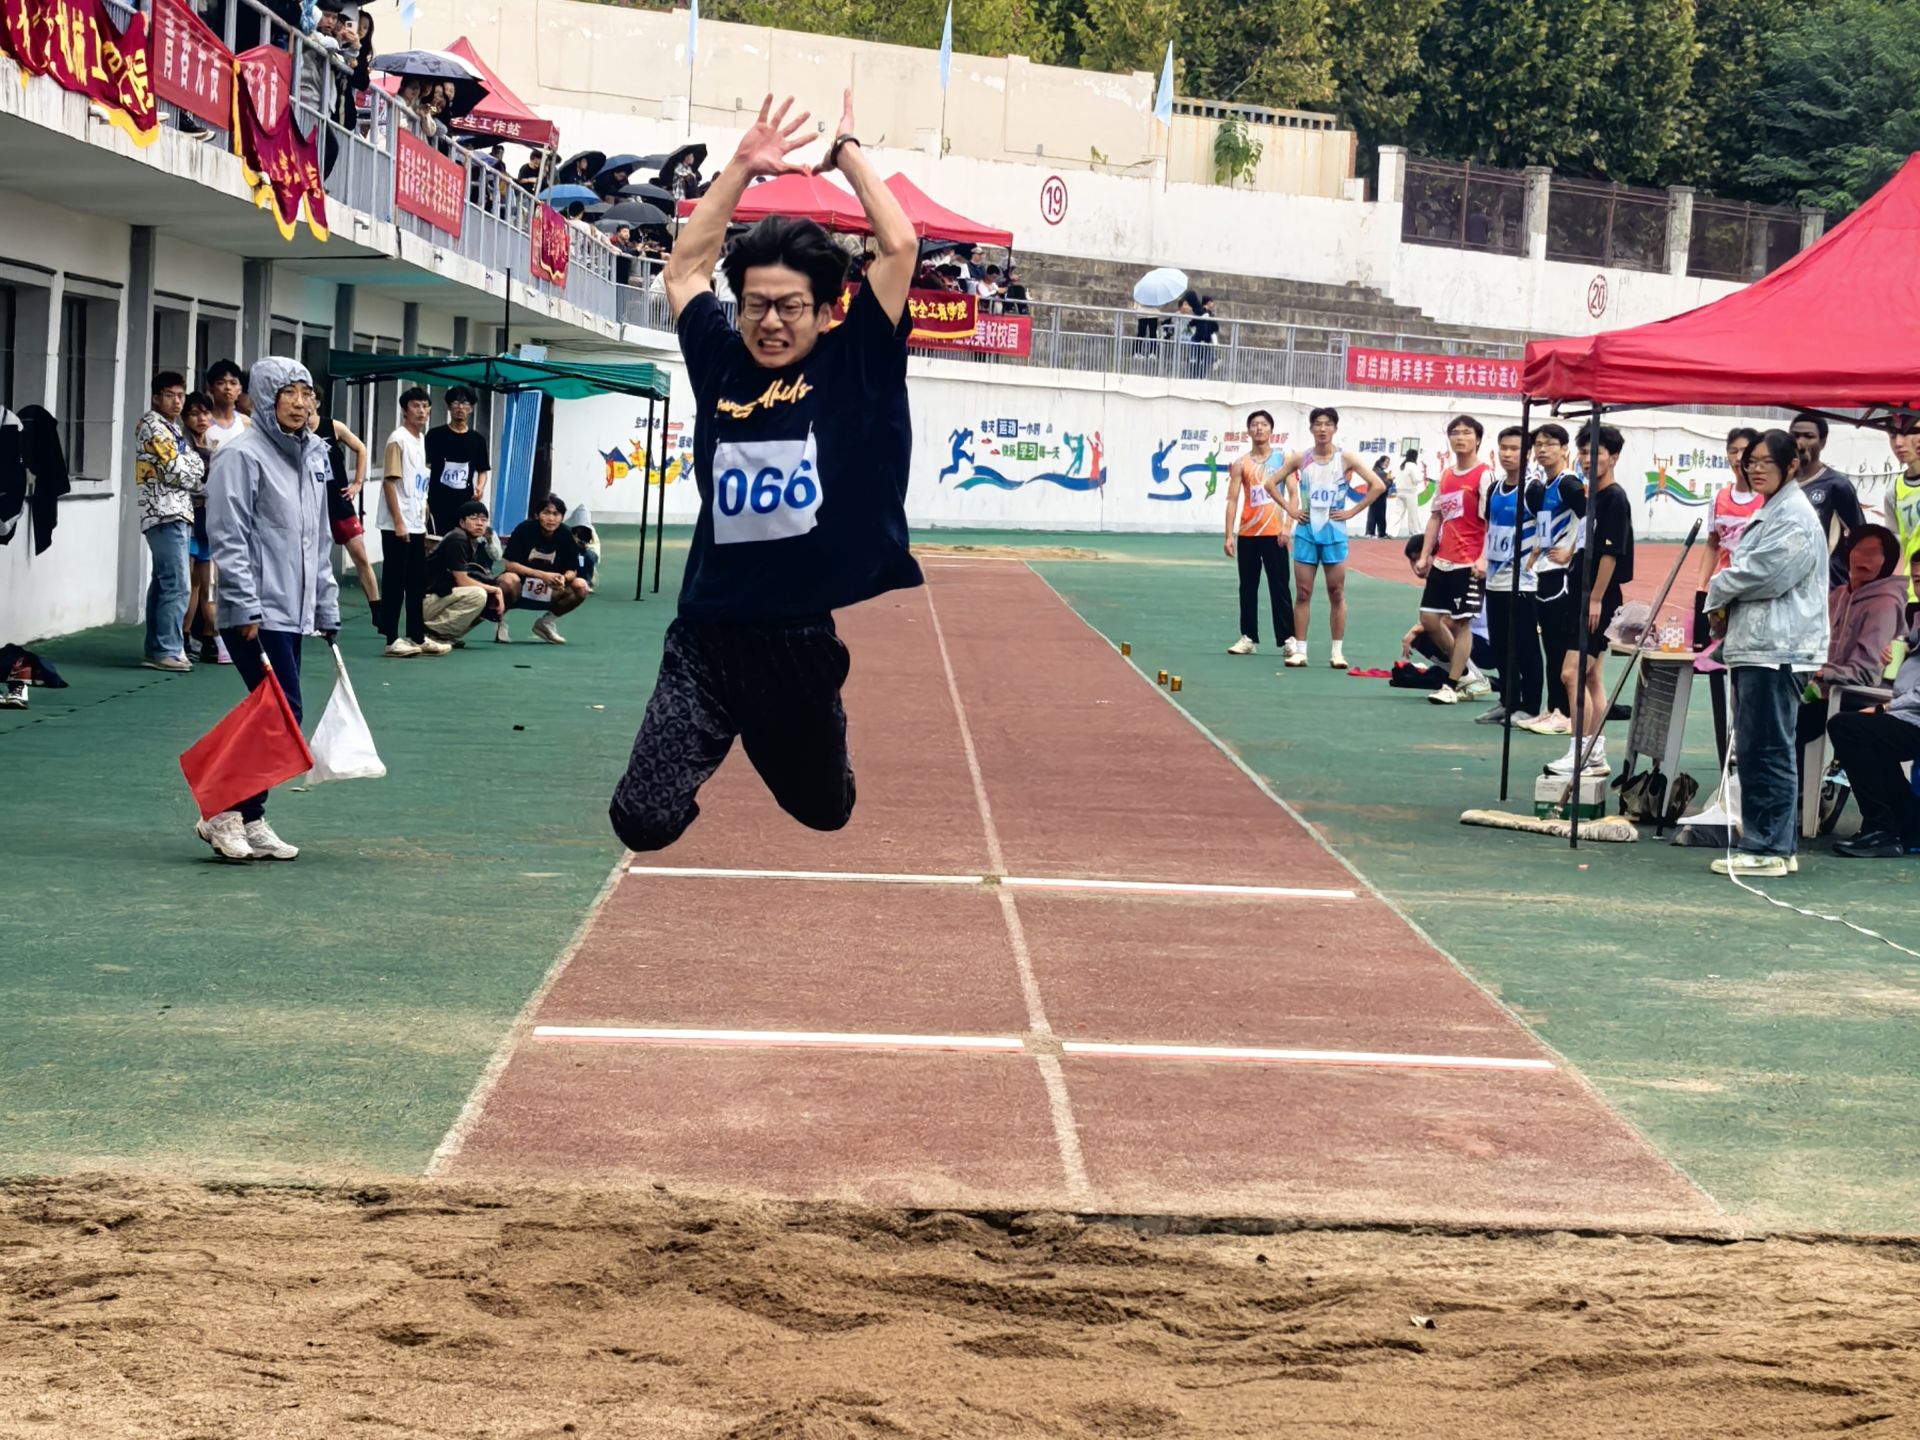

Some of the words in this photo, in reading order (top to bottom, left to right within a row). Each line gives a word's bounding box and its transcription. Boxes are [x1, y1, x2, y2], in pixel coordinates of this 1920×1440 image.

[1046, 185, 1063, 216] 19
[1591, 283, 1606, 310] 20
[718, 459, 817, 517] 066
[1311, 489, 1337, 504] 407
